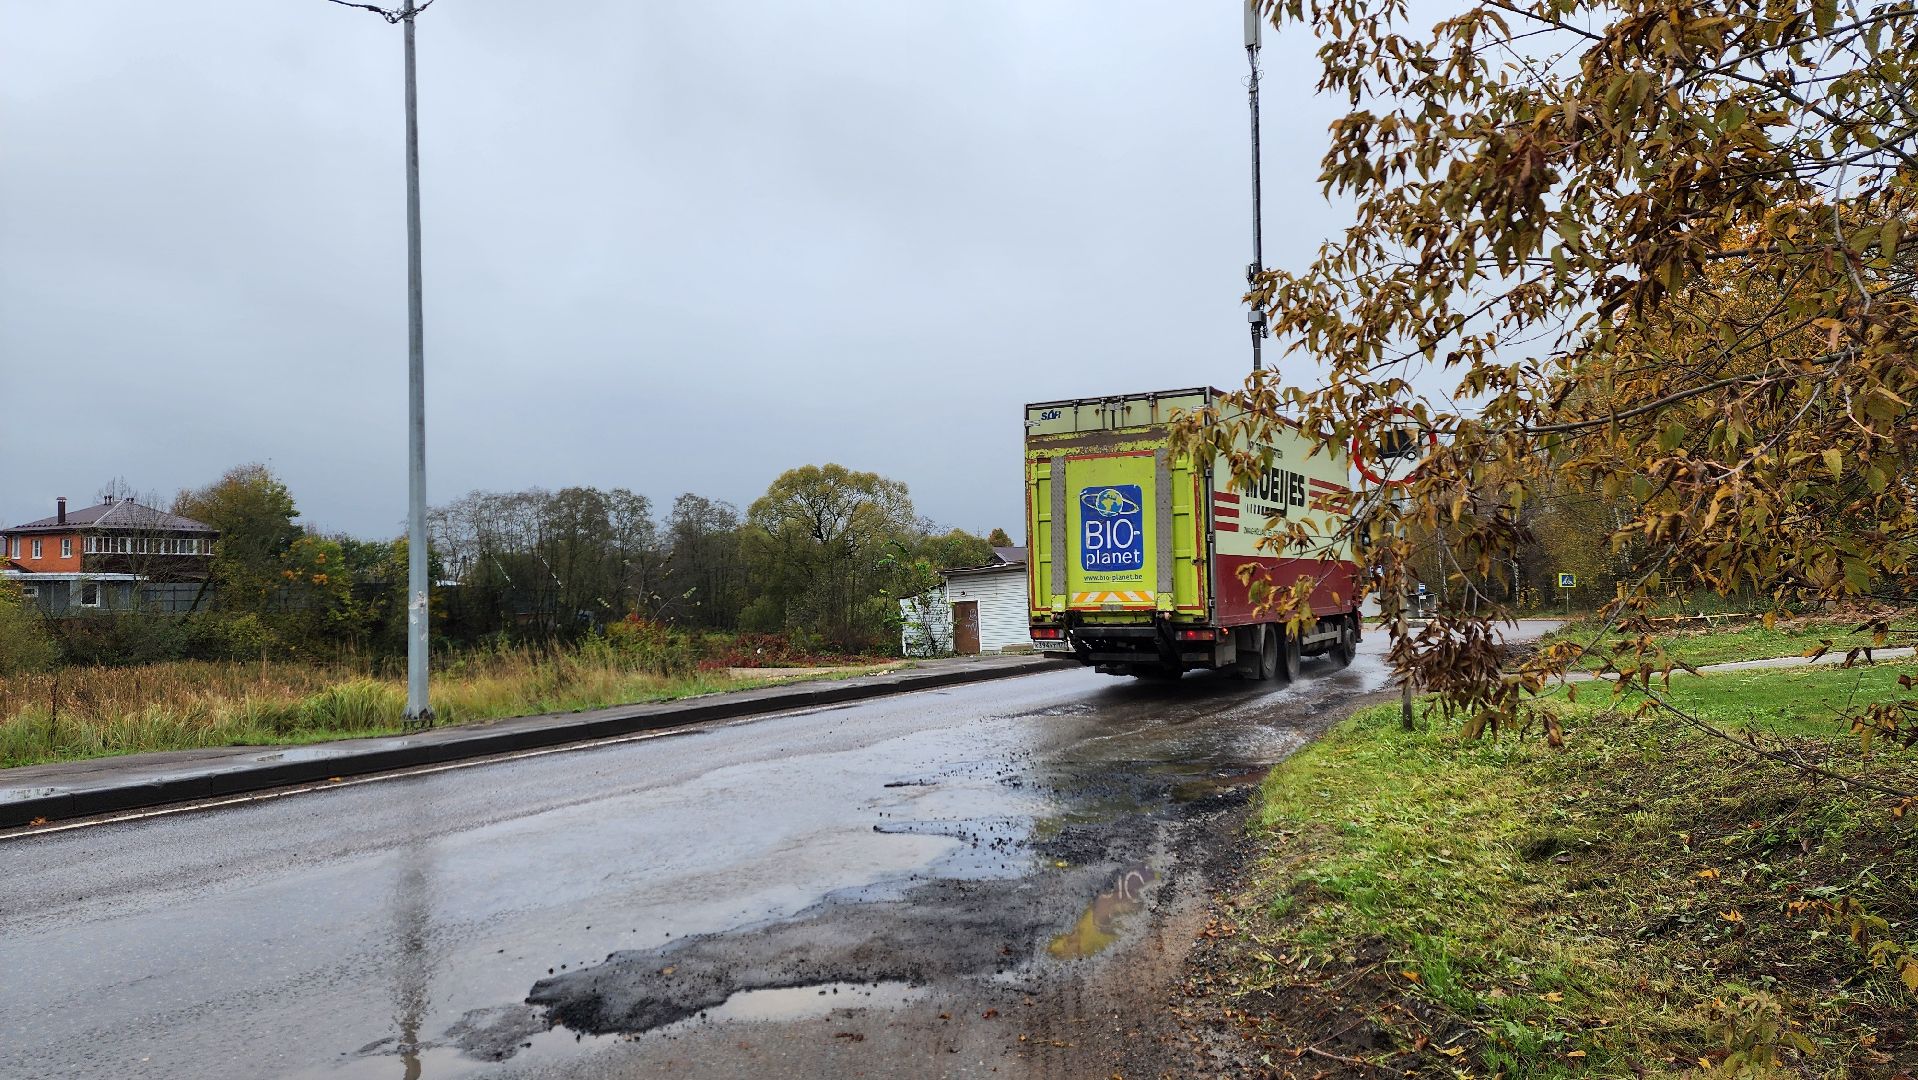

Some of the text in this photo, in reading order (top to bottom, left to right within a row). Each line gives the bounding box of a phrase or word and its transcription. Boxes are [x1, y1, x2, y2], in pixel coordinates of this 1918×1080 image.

[1085, 518, 1140, 549] BIO-
[1086, 549, 1140, 570] planet
[1083, 573, 1143, 581] www.bio-planet.be
